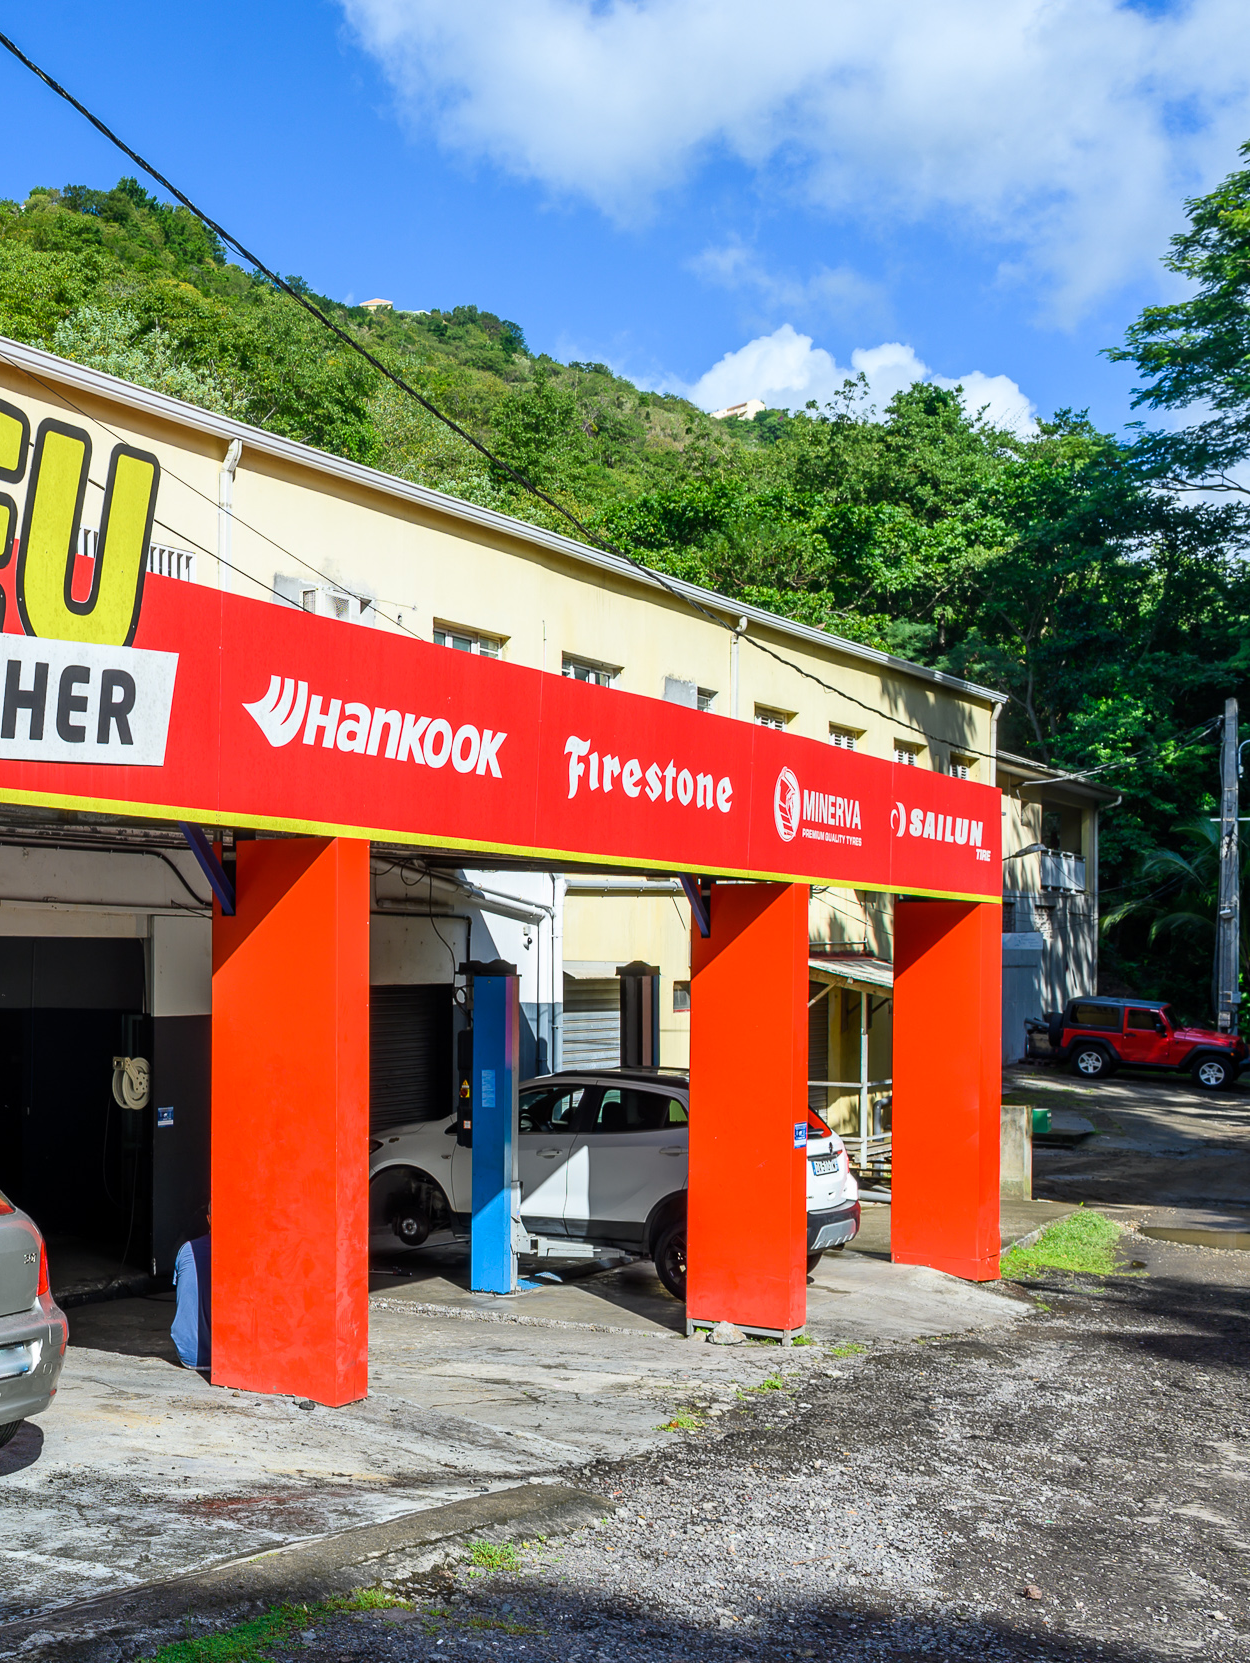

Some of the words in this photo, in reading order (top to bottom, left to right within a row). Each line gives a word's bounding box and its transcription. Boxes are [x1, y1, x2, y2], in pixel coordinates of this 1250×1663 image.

[563, 735, 734, 813] Firestone
[802, 789, 862, 830] MINERVA
[909, 808, 984, 848] SAILUN
[802, 828, 825, 841] PREMIUM
[825, 832, 845, 844] QUALITY
[845, 835, 862, 847] TYRES
[976, 848, 991, 862] TIRE
